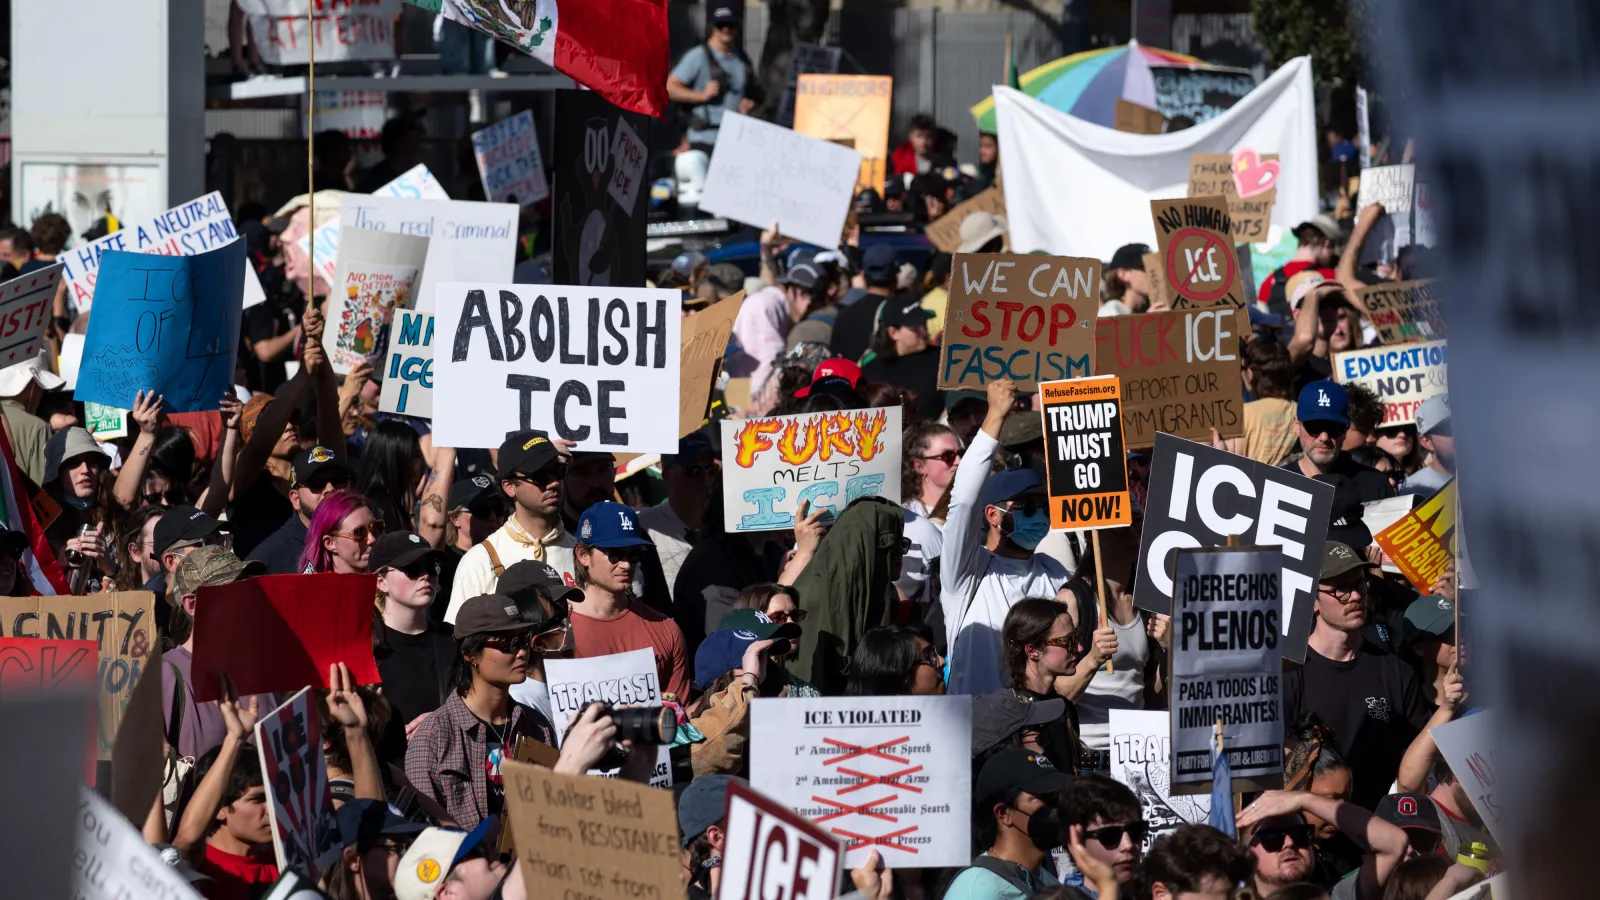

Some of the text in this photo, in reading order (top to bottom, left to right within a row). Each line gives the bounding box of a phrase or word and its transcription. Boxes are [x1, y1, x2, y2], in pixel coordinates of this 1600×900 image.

[138, 225, 152, 249] A
[153, 195, 227, 239] NEUTRAL
[1157, 204, 1231, 235] NO HUMAN
[962, 260, 1093, 299] WE CAN
[1184, 247, 1221, 284] ICE
[452, 290, 667, 368] ABOLISH
[962, 301, 1076, 346] STOP
[1185, 309, 1236, 363] ICE
[944, 343, 1090, 385] FASCISM
[1045, 384, 1116, 398] RefuseFascism.org
[1186, 372, 1219, 395] OUR
[1318, 389, 1331, 407] LA
[1377, 374, 1425, 397] NOT
[505, 374, 629, 446] ICE
[1047, 402, 1117, 432] TRUMP
[735, 408, 887, 468] FURY
[1057, 432, 1112, 461] MUST
[772, 459, 860, 485] MELTS
[1073, 463, 1101, 490] GO
[618, 511, 634, 531] LA
[1061, 495, 1121, 523] NOW!
[1168, 452, 1314, 561] ICE
[1386, 515, 1421, 546] TO
[1182, 573, 1279, 609] ¡DERECHOS
[1182, 610, 1279, 652] PLENOS
[551, 673, 657, 712] TRAKAS!
[1180, 677, 1279, 701] PARA TODOS LOS
[804, 710, 922, 725] ICE VIOLATED
[1179, 700, 1280, 729] INMIGRANTES!
[272, 712, 307, 763] ICE
[810, 745, 862, 756] Amendment
[901, 743, 931, 755] Speech
[275, 747, 317, 805] OUT
[812, 775, 864, 786] Amendment
[905, 773, 930, 785] Arms
[920, 802, 950, 815] Search
[578, 820, 678, 858] RESISTANCE
[898, 835, 931, 845] Process
